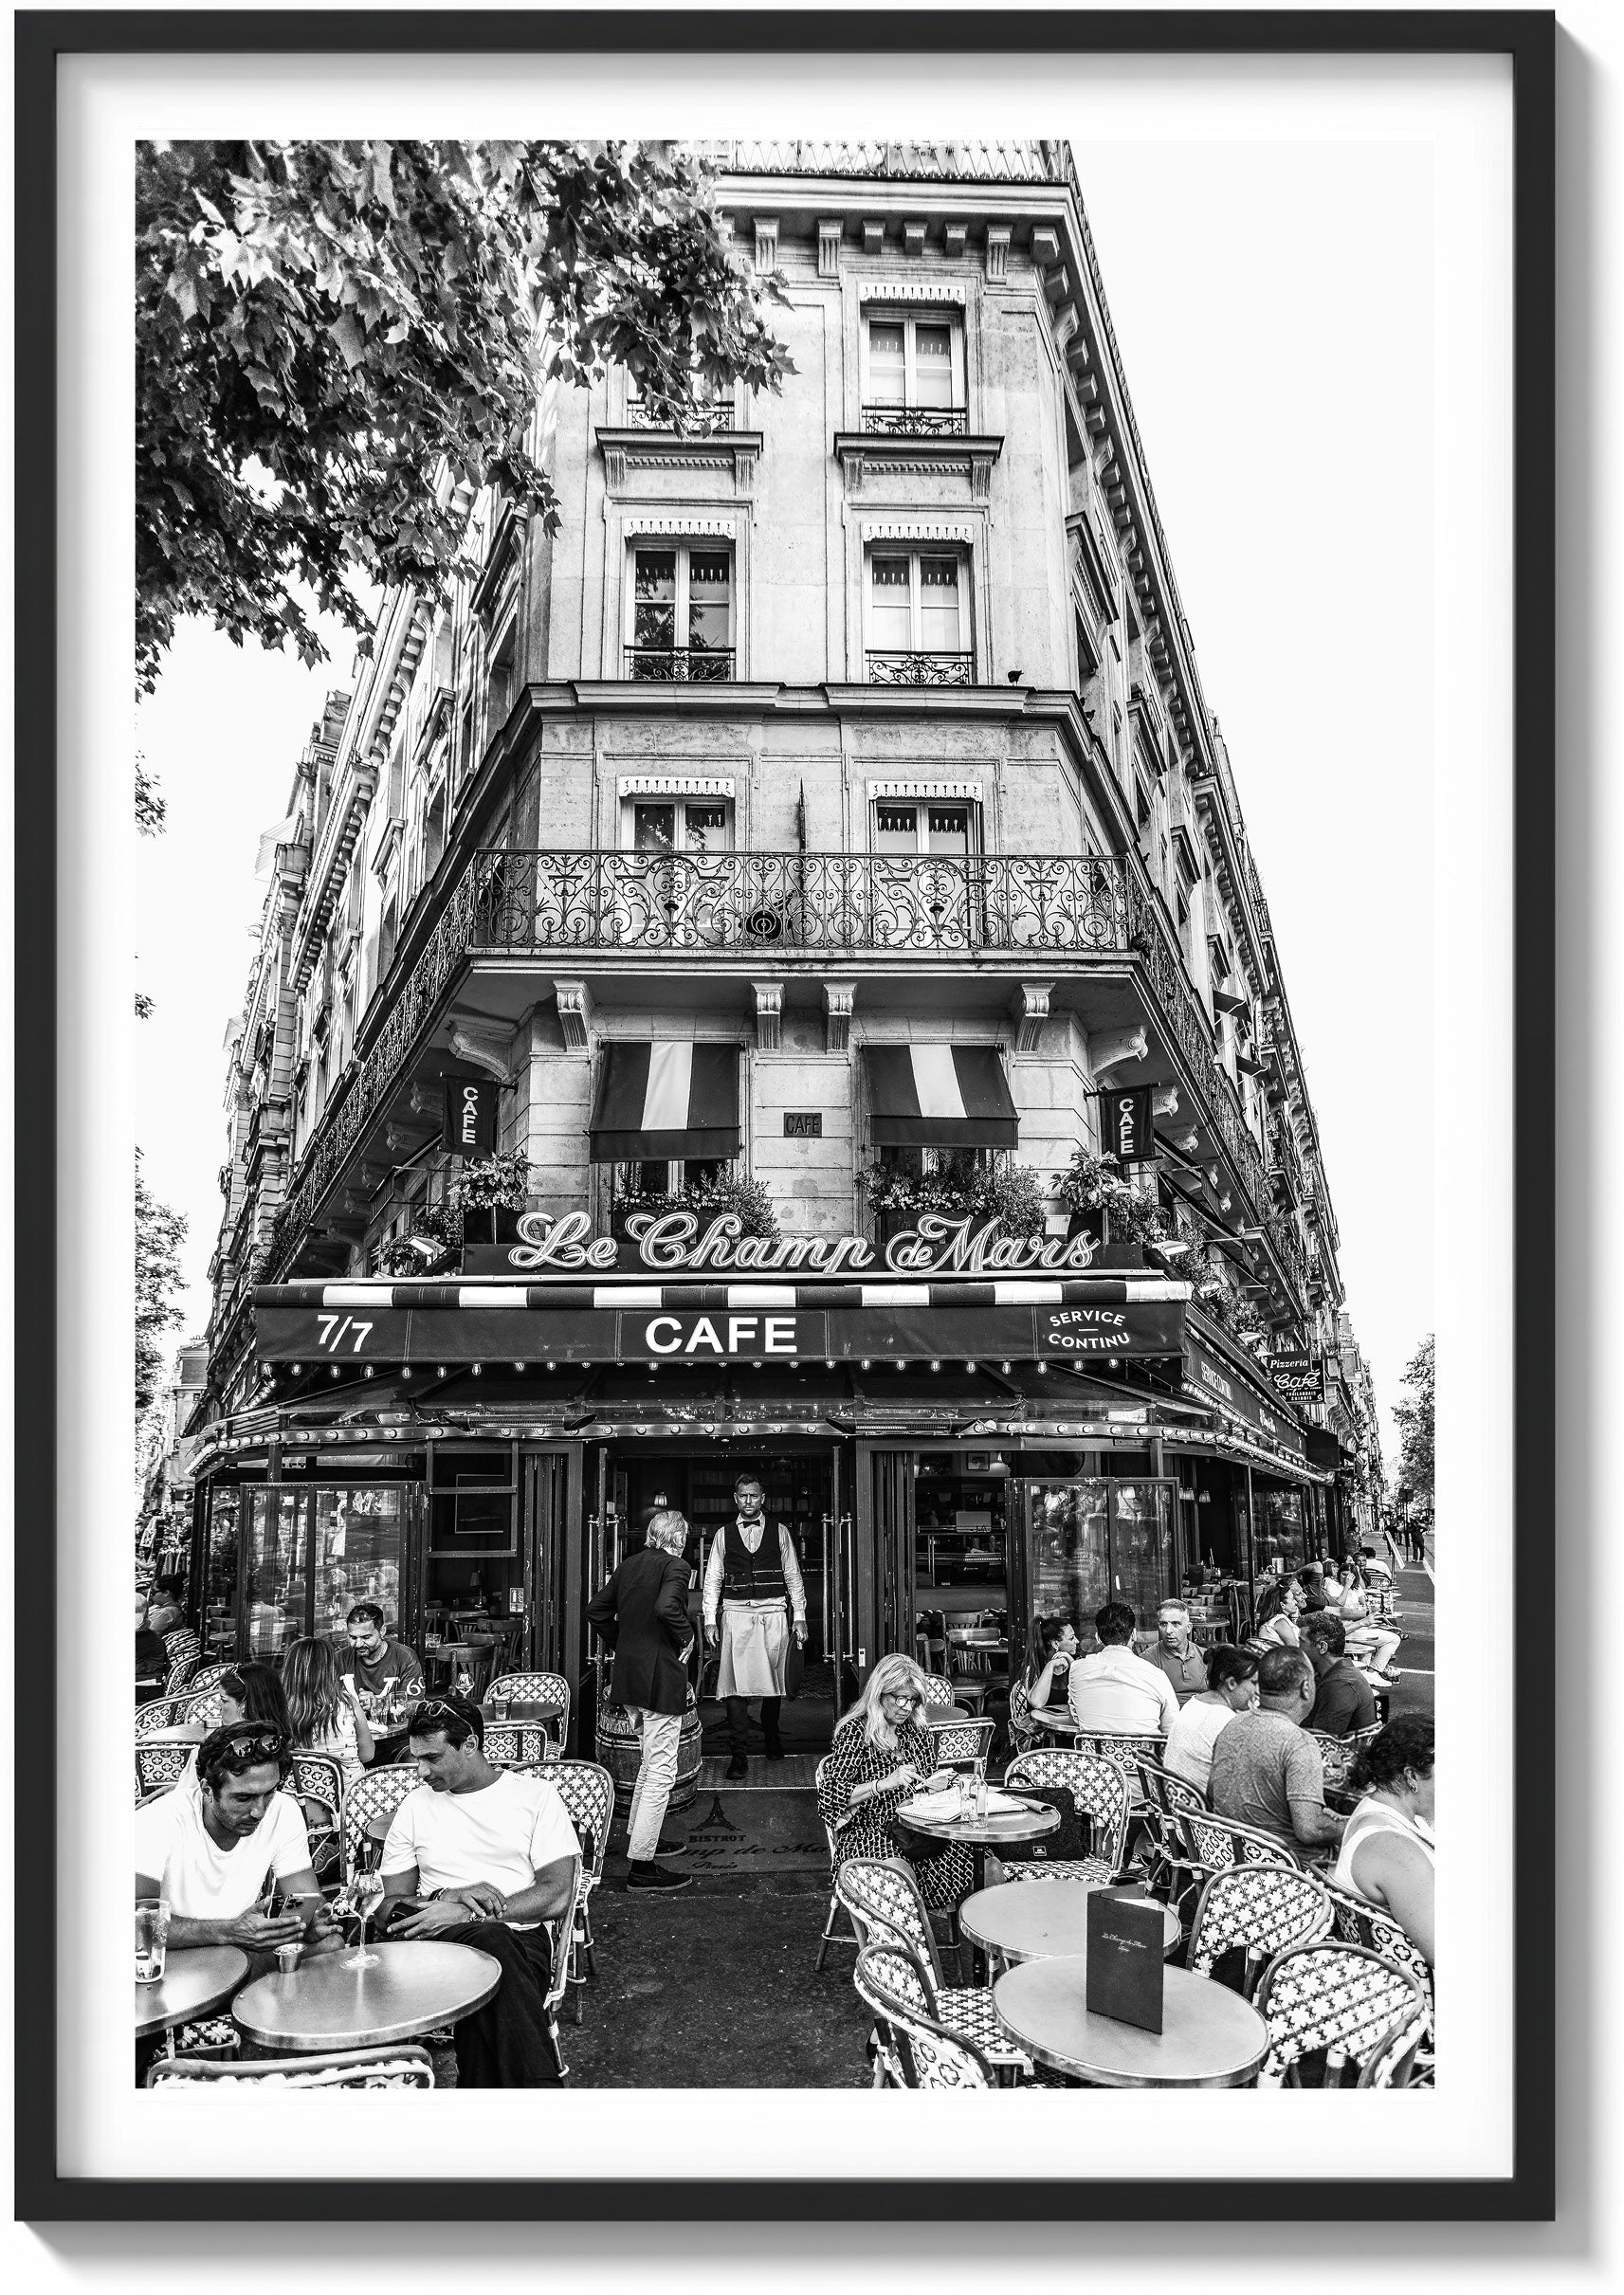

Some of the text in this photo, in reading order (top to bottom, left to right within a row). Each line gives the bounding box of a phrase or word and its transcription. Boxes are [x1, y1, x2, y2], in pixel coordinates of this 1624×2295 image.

[463, 1086, 479, 1144] CAFE
[1119, 1098, 1135, 1155] CAFE
[508, 1211, 1100, 1274] Le Champ de Mars
[318, 1314, 374, 1353] 7/7
[645, 1316, 798, 1354] CAFE
[1049, 1310, 1126, 1327] SERVICE
[1049, 1332, 1130, 1349] CONTINU
[1270, 1359, 1308, 1369] Pizzeria
[688, 1834, 747, 1843] BISTROT
